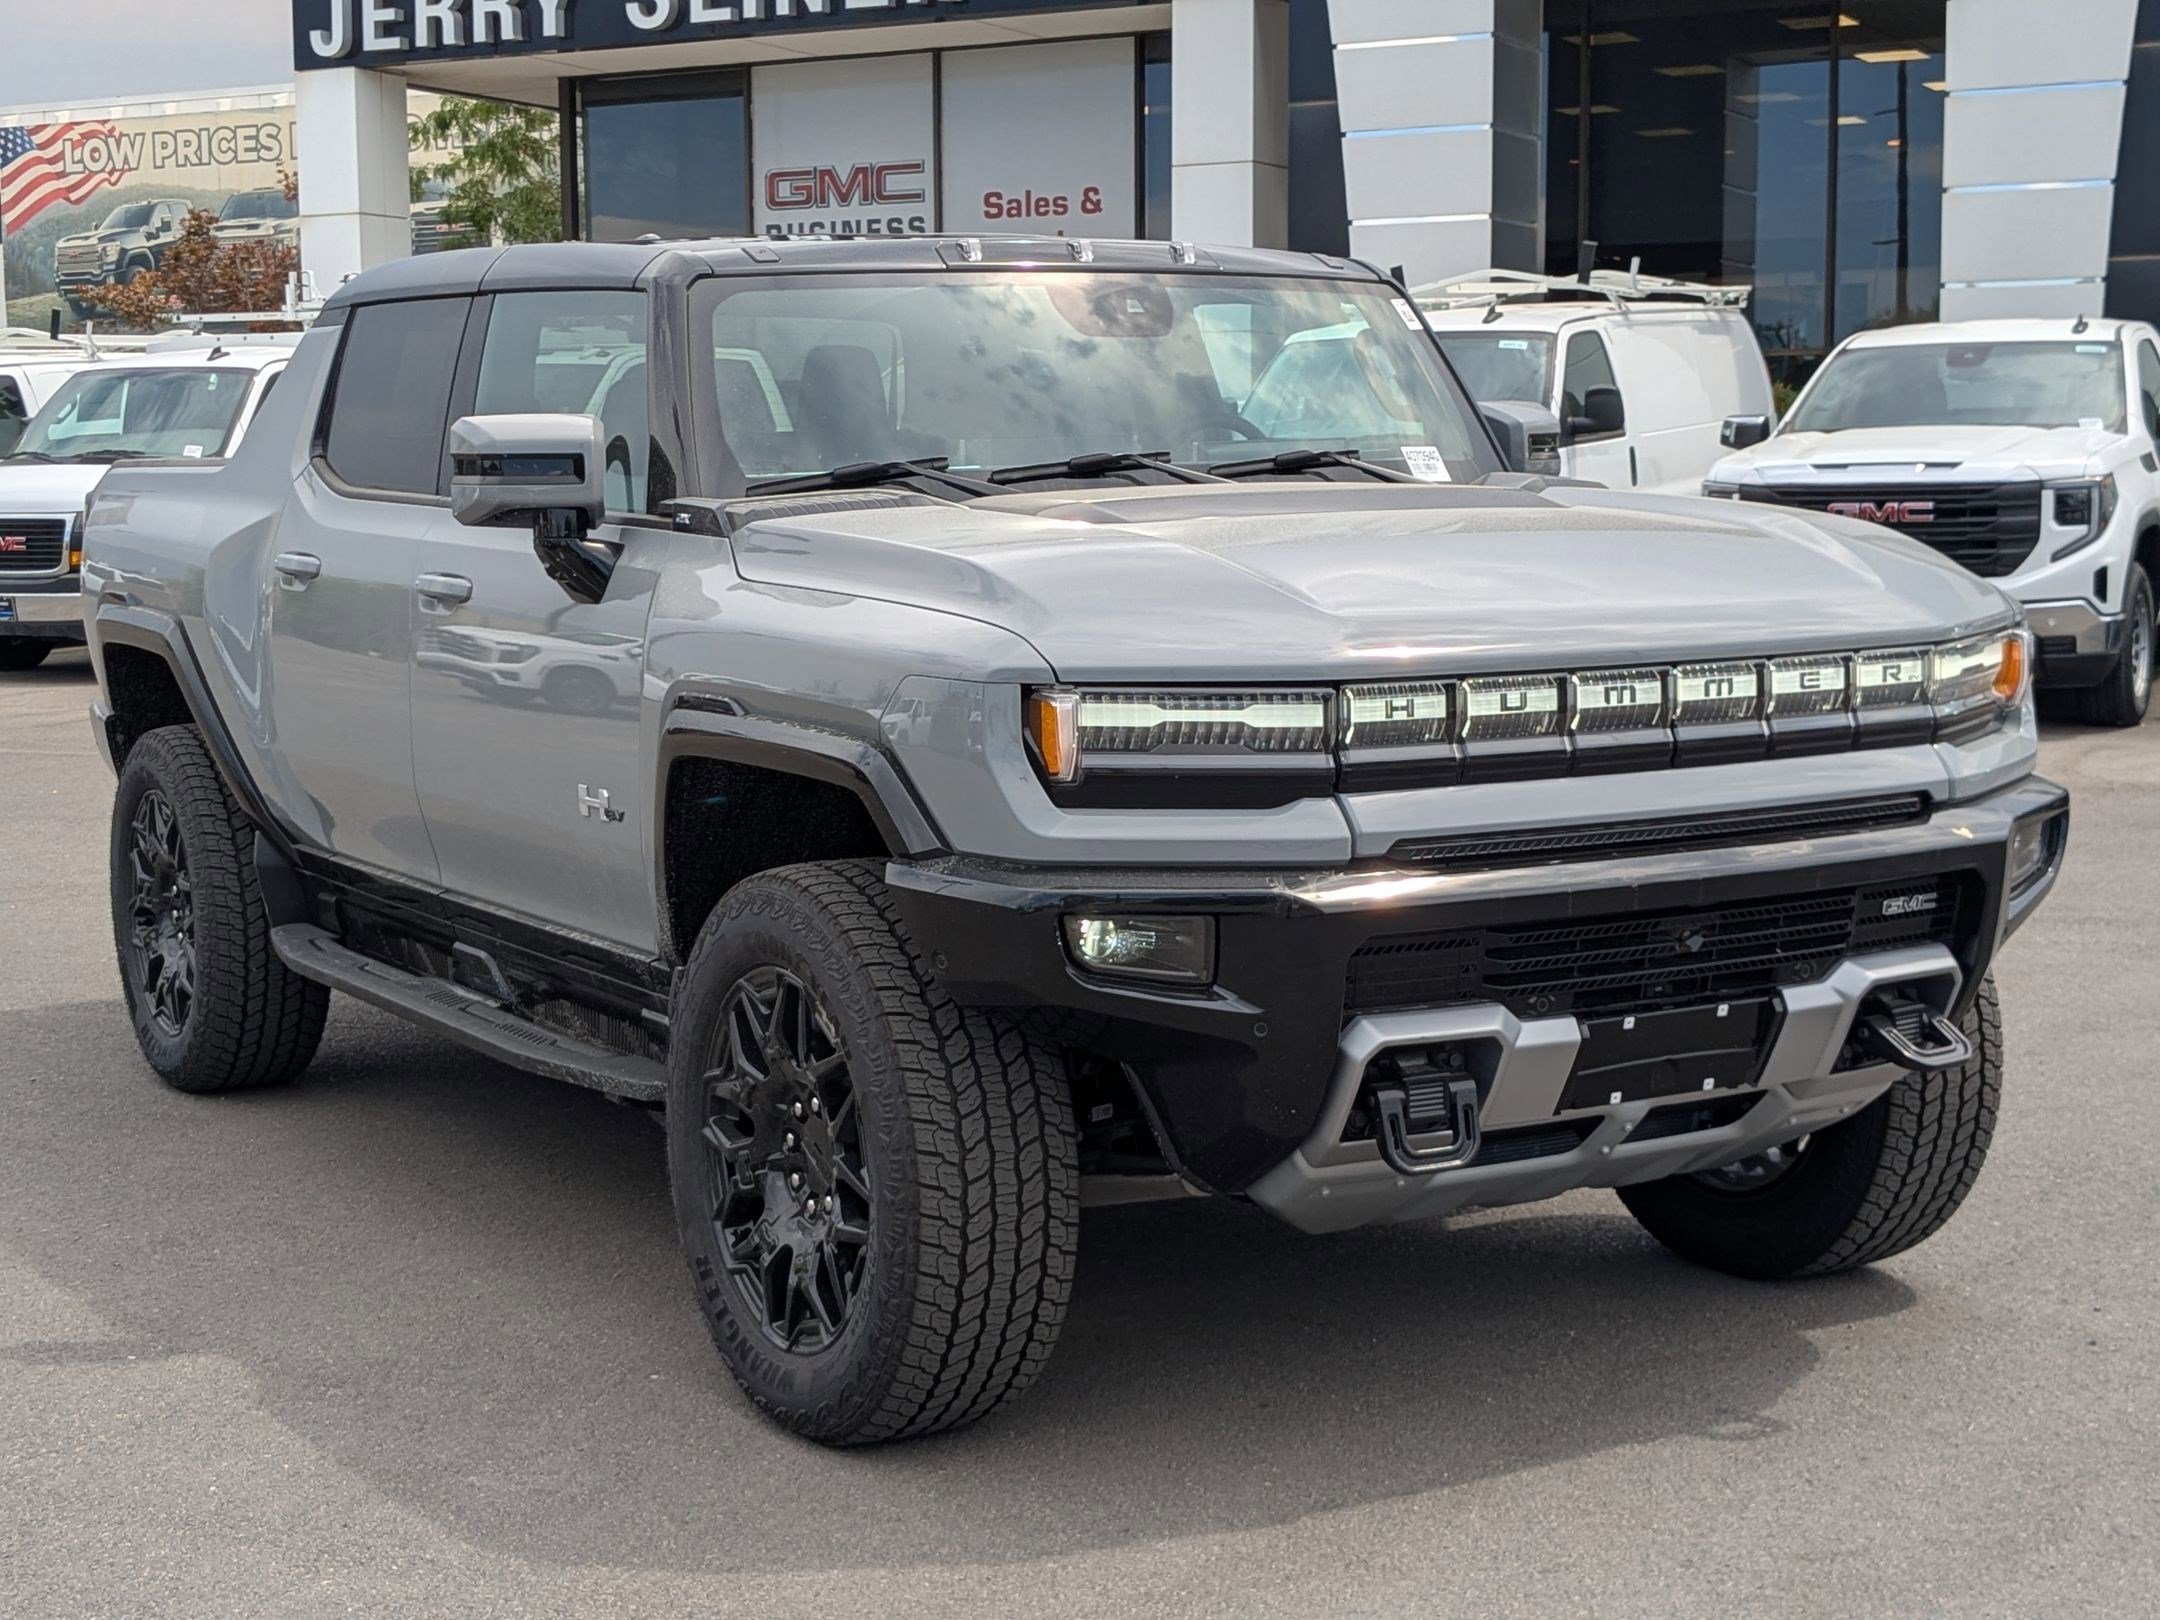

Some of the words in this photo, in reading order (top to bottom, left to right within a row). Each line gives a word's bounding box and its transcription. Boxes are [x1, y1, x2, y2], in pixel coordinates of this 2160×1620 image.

[309, 0, 567, 58] JERRY
[62, 132, 147, 174] LOW
[153, 121, 282, 169] PRICES
[764, 159, 926, 211] GMC
[983, 190, 1069, 220] Sales
[1080, 186, 1104, 215] &
[1826, 501, 1936, 523] GMC
[0, 536, 27, 551] MC
[1385, 664, 1902, 719] HUMMER
[1882, 892, 1937, 915] GMC
[695, 1254, 798, 1395] WRANGLER
